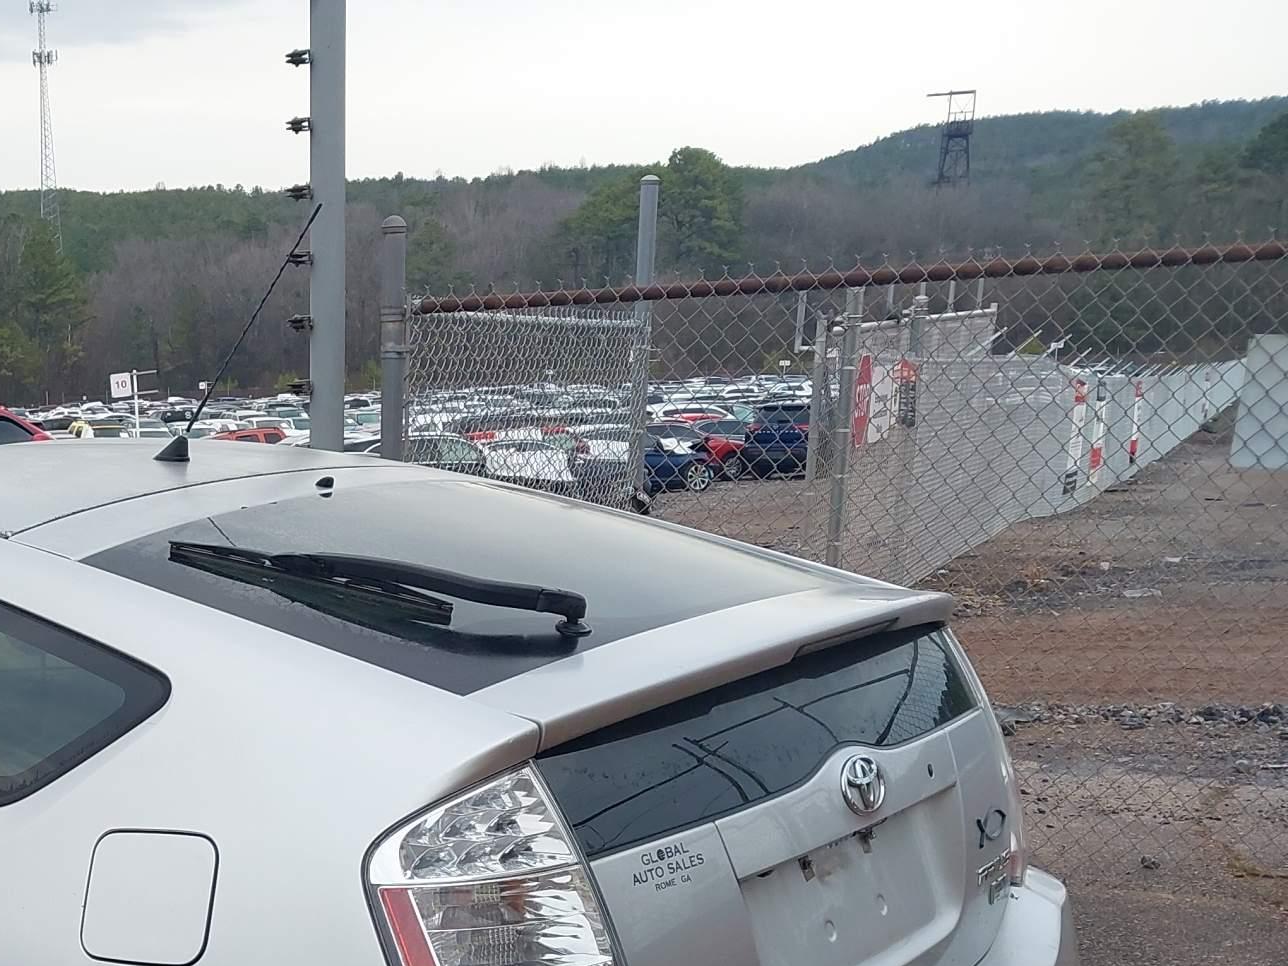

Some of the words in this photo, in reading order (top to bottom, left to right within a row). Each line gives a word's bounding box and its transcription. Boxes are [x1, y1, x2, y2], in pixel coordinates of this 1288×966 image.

[115, 379, 128, 389] 10
[640, 842, 690, 866] GLOBAL
[632, 865, 665, 886] AUTO
[667, 853, 705, 875] SALES
[655, 878, 678, 892] ROME
